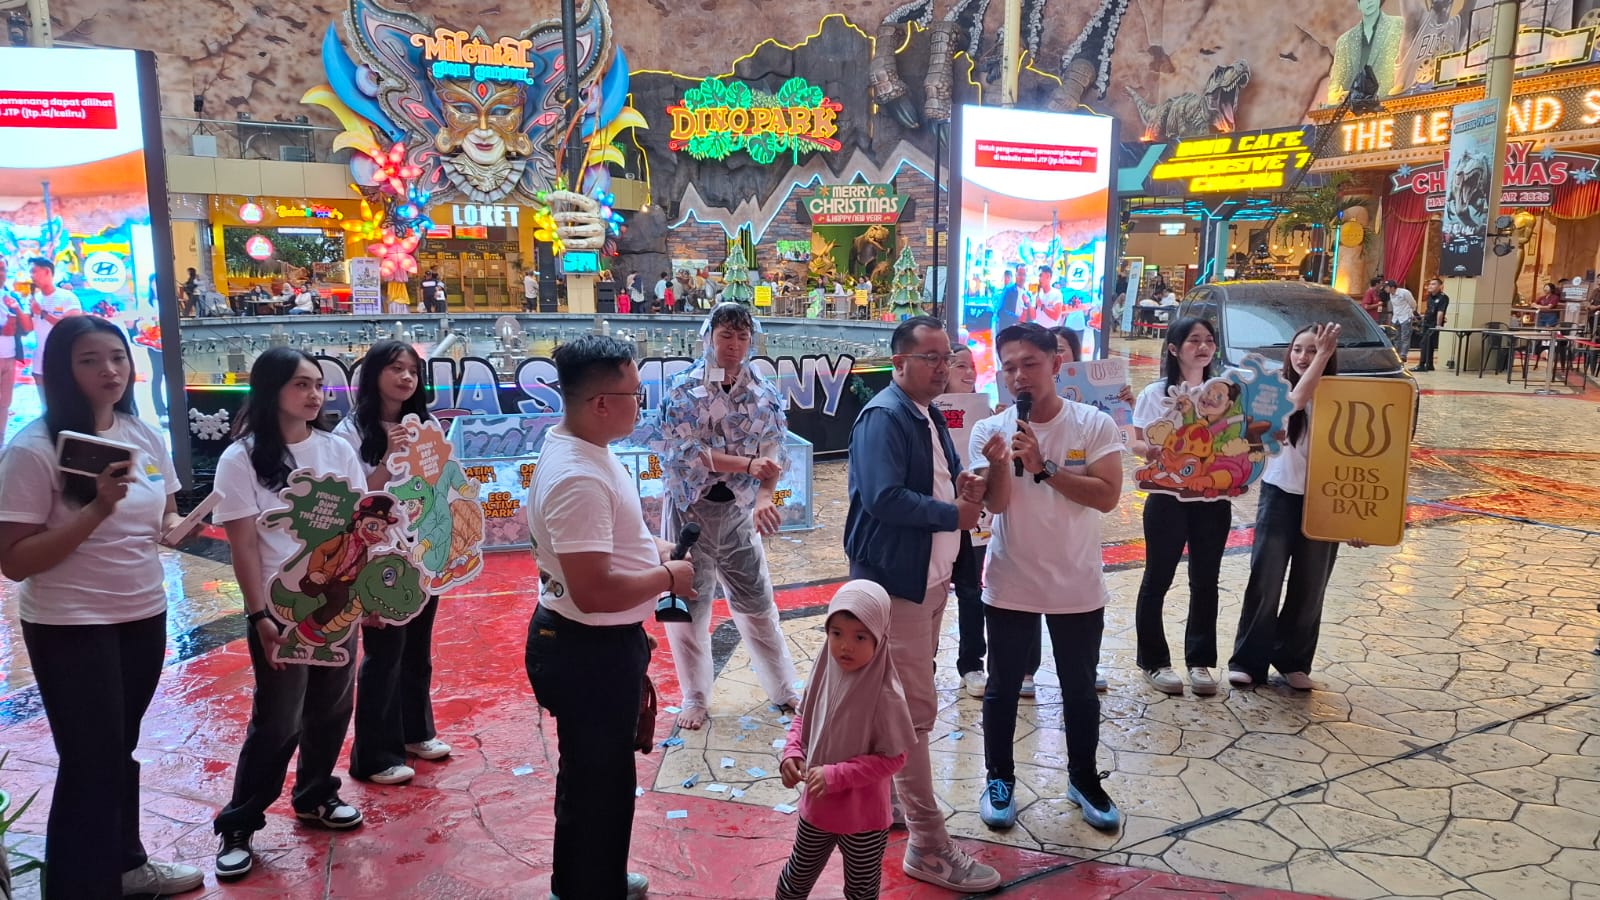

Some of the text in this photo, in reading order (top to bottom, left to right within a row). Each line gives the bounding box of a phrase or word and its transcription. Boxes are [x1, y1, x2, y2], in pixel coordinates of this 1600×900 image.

[0, 98, 48, 109] emenang
[671, 107, 838, 140] DINO PARK
[1341, 118, 1394, 152] THE
[1411, 97, 1564, 145] LEND
[1237, 131, 1305, 151] CAFE
[832, 185, 876, 198] MERRY
[809, 197, 899, 214] CHRISTMAS
[452, 204, 519, 227] LOKET
[464, 466, 494, 477] ATIM
[1334, 466, 1380, 484] UBS
[488, 491, 511, 501] ECO
[1321, 481, 1390, 501] GOLD
[485, 509, 514, 519] PARK
[1333, 498, 1379, 521] BAR
